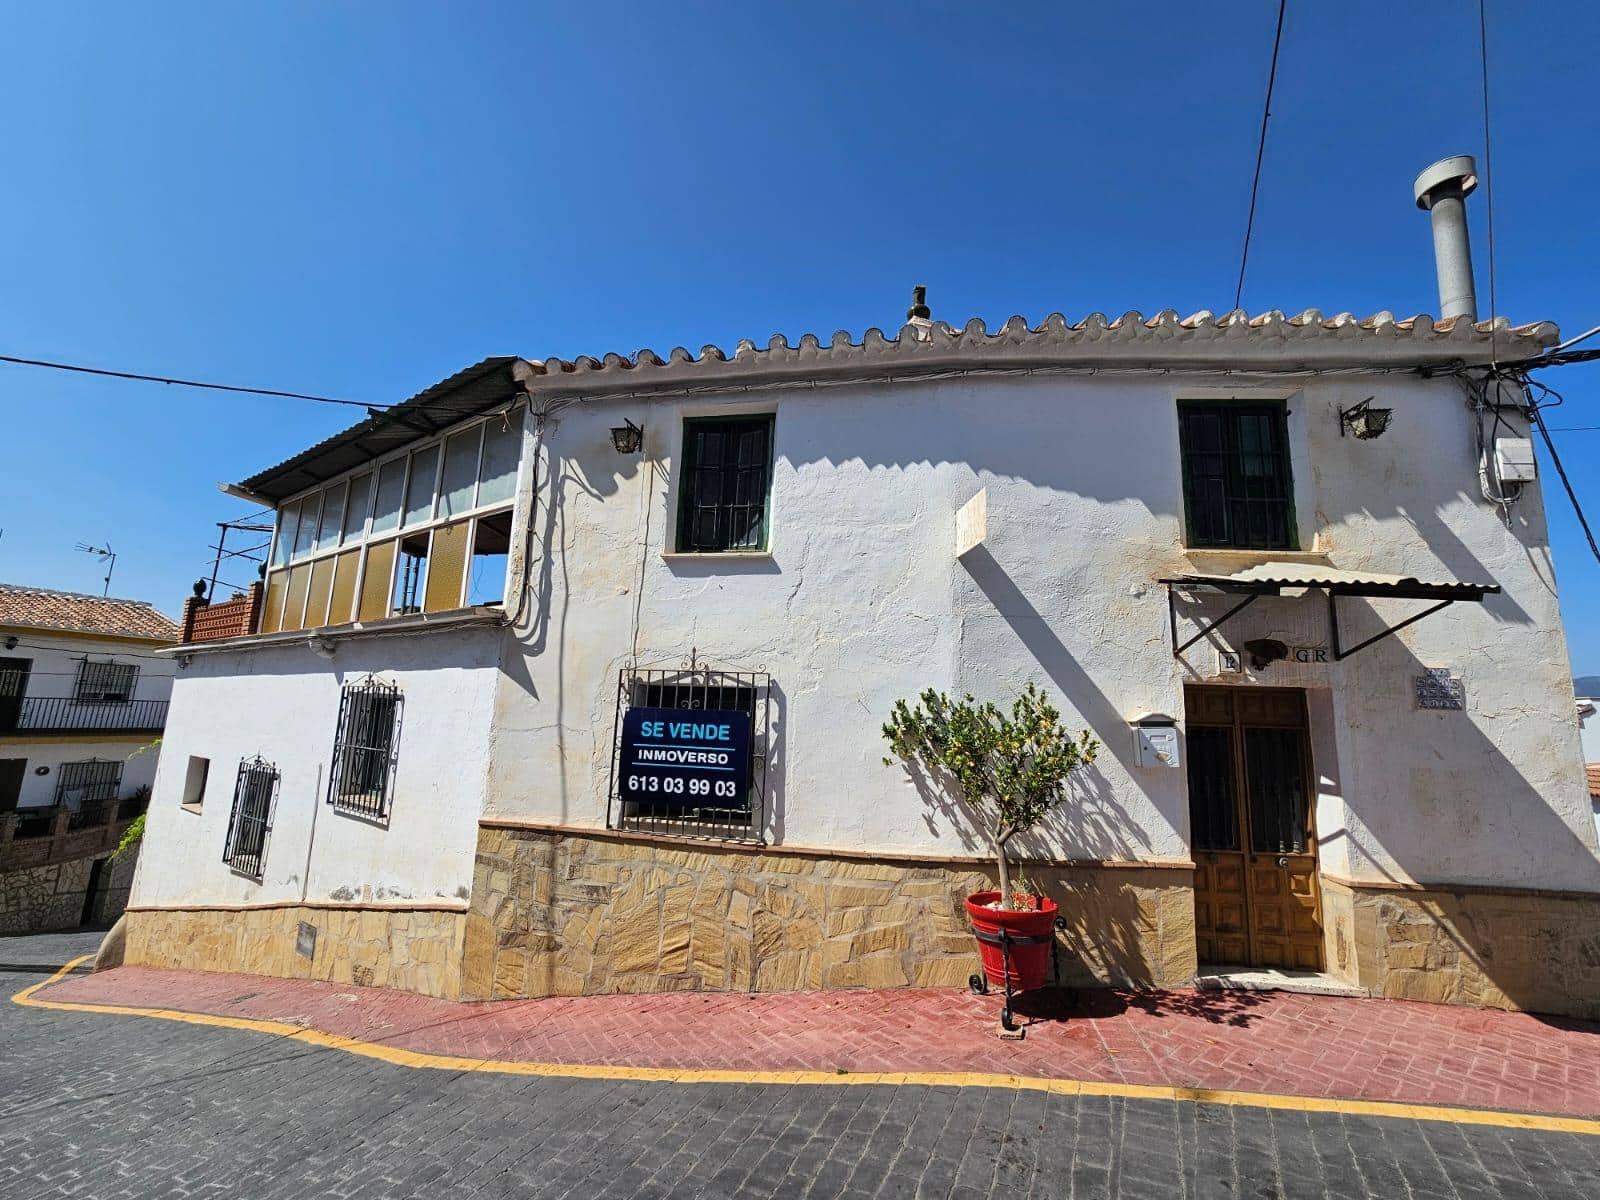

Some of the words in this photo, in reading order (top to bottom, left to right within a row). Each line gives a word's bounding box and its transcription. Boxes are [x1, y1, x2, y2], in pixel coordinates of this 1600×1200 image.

[640, 721, 664, 737] SE
[669, 722, 730, 740] VENDE
[638, 749, 729, 765] INMOVERSO
[628, 775, 658, 792] 613
[663, 777, 684, 794] 03
[689, 779, 710, 795] 99
[715, 781, 736, 797] 03
